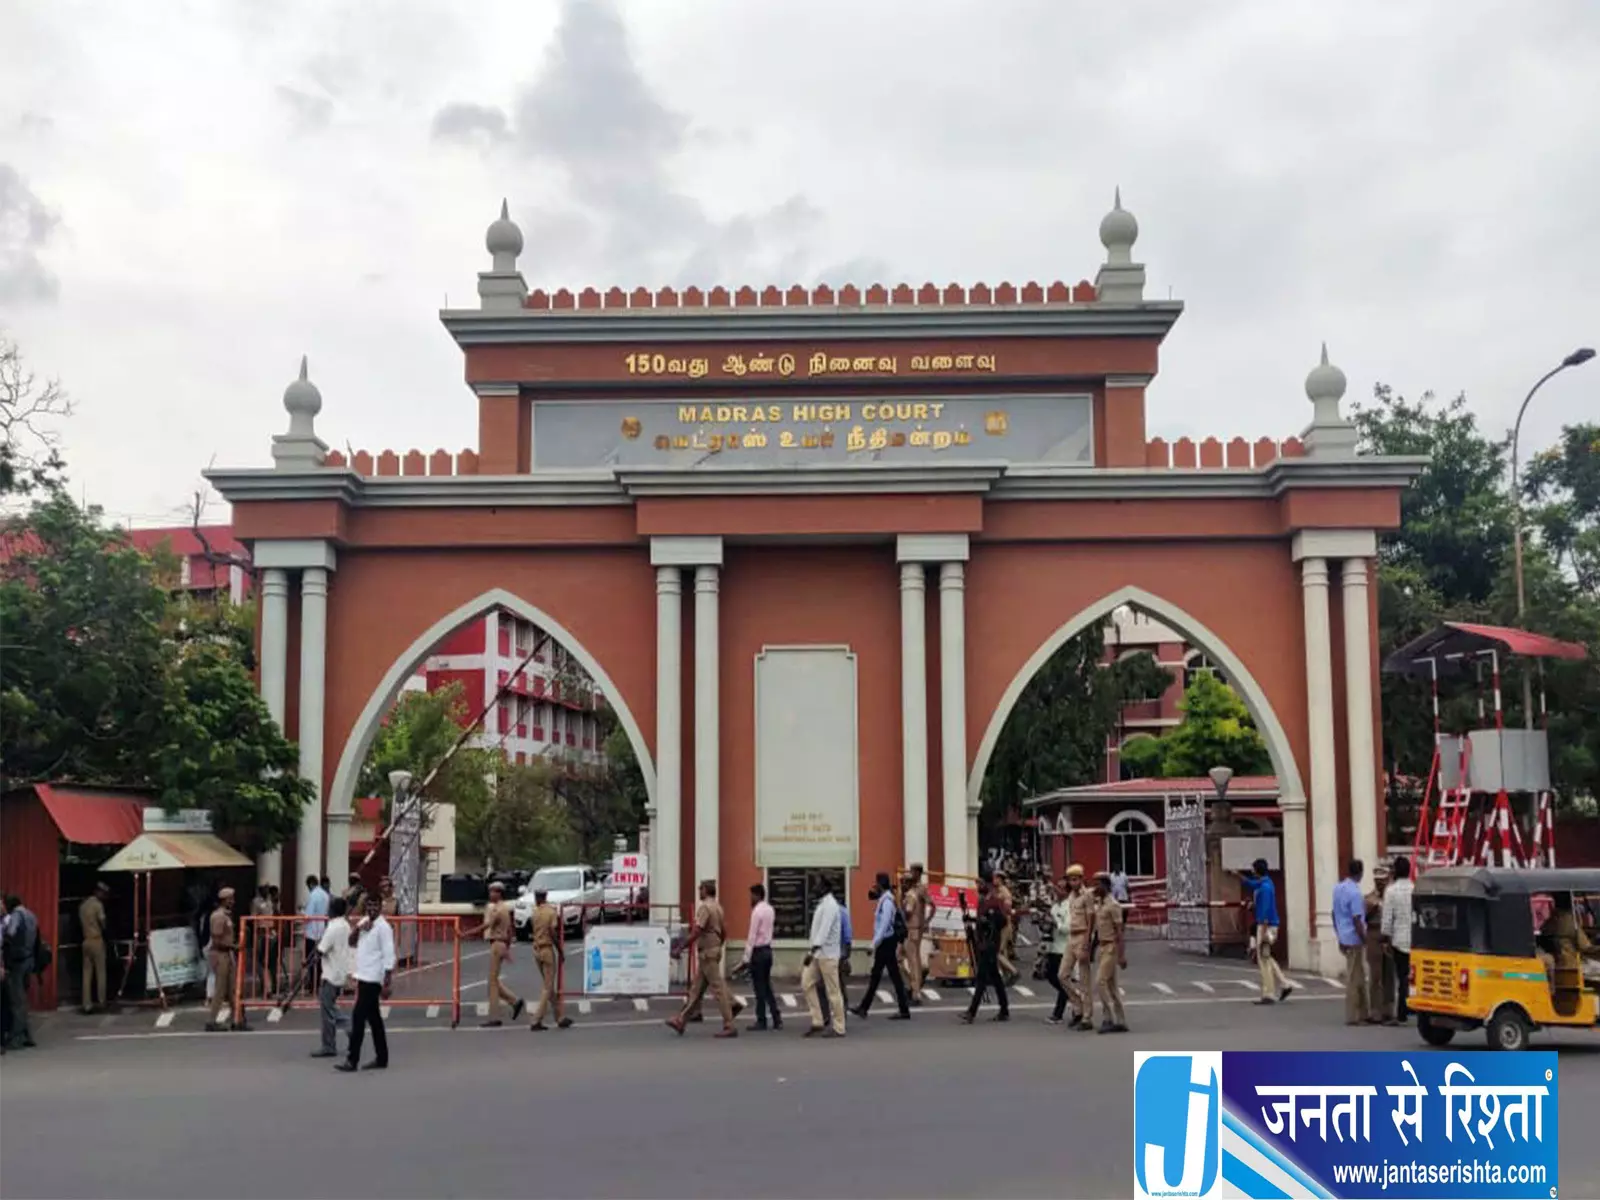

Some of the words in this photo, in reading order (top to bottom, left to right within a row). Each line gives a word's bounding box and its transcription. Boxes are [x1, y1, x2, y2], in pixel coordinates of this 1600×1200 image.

[625, 353, 709, 379] 150வது
[721, 352, 796, 376] ஆண்டு
[808, 351, 897, 376] நினைவு
[911, 354, 996, 372] வளைவு
[678, 404, 782, 422] MADRAS
[792, 403, 852, 422] HIGH
[861, 402, 944, 421] COURT
[623, 857, 637, 867] NO
[614, 873, 645, 883] ENTRY
